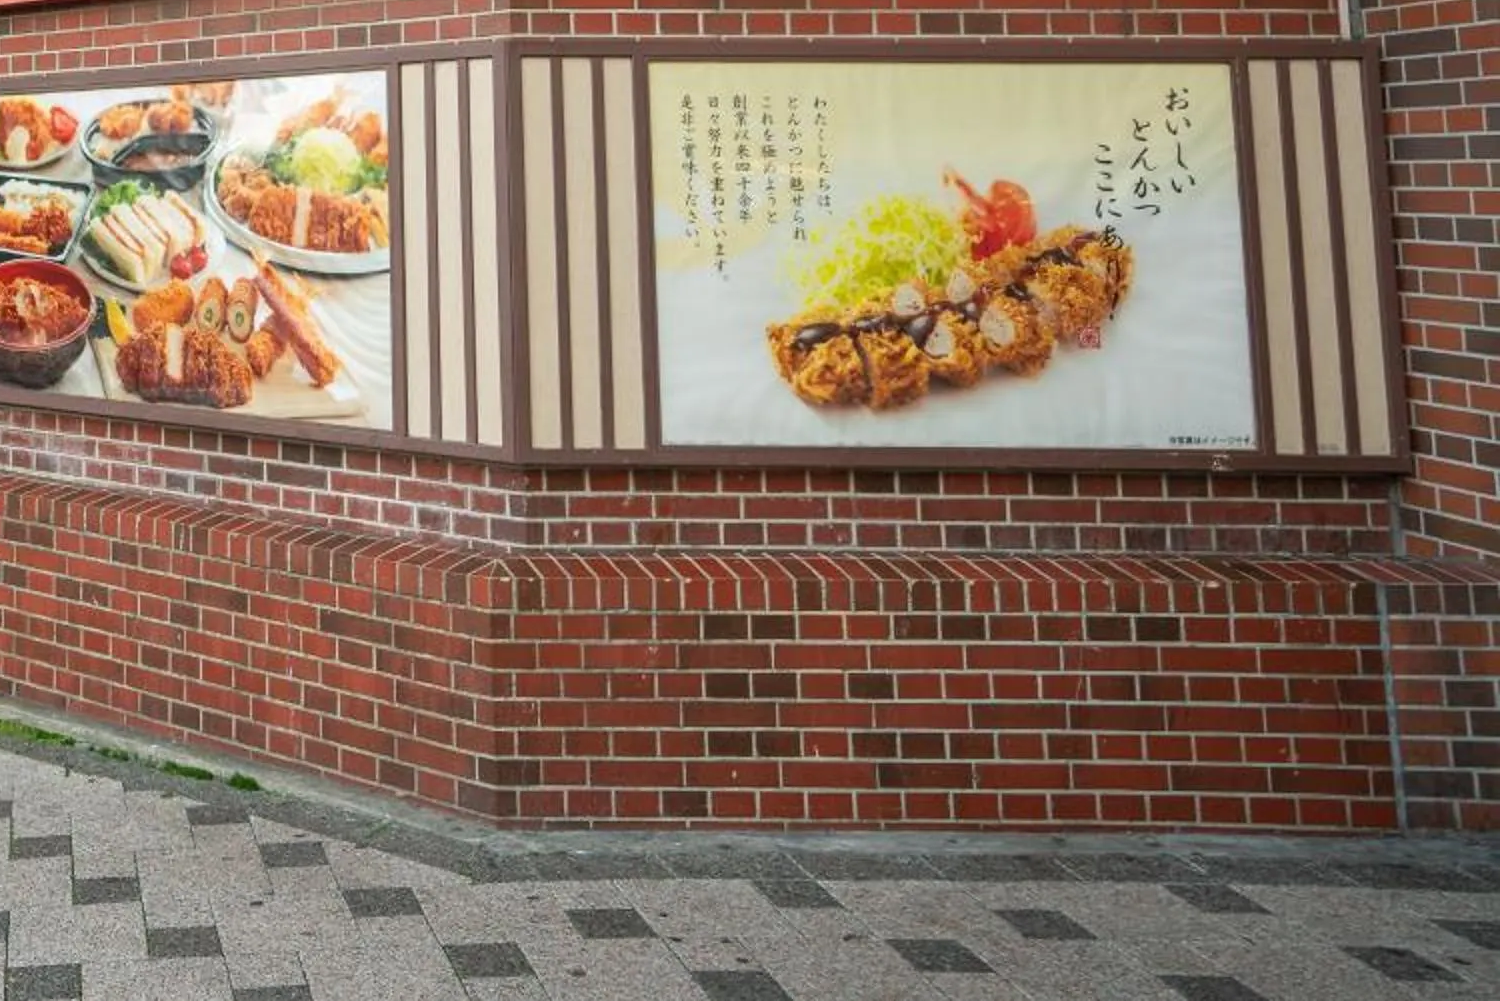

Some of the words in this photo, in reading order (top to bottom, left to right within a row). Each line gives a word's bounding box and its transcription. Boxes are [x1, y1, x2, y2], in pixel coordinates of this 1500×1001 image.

[1130, 118, 1161, 216] とんかつ
[1166, 87, 1196, 194] おいしい
